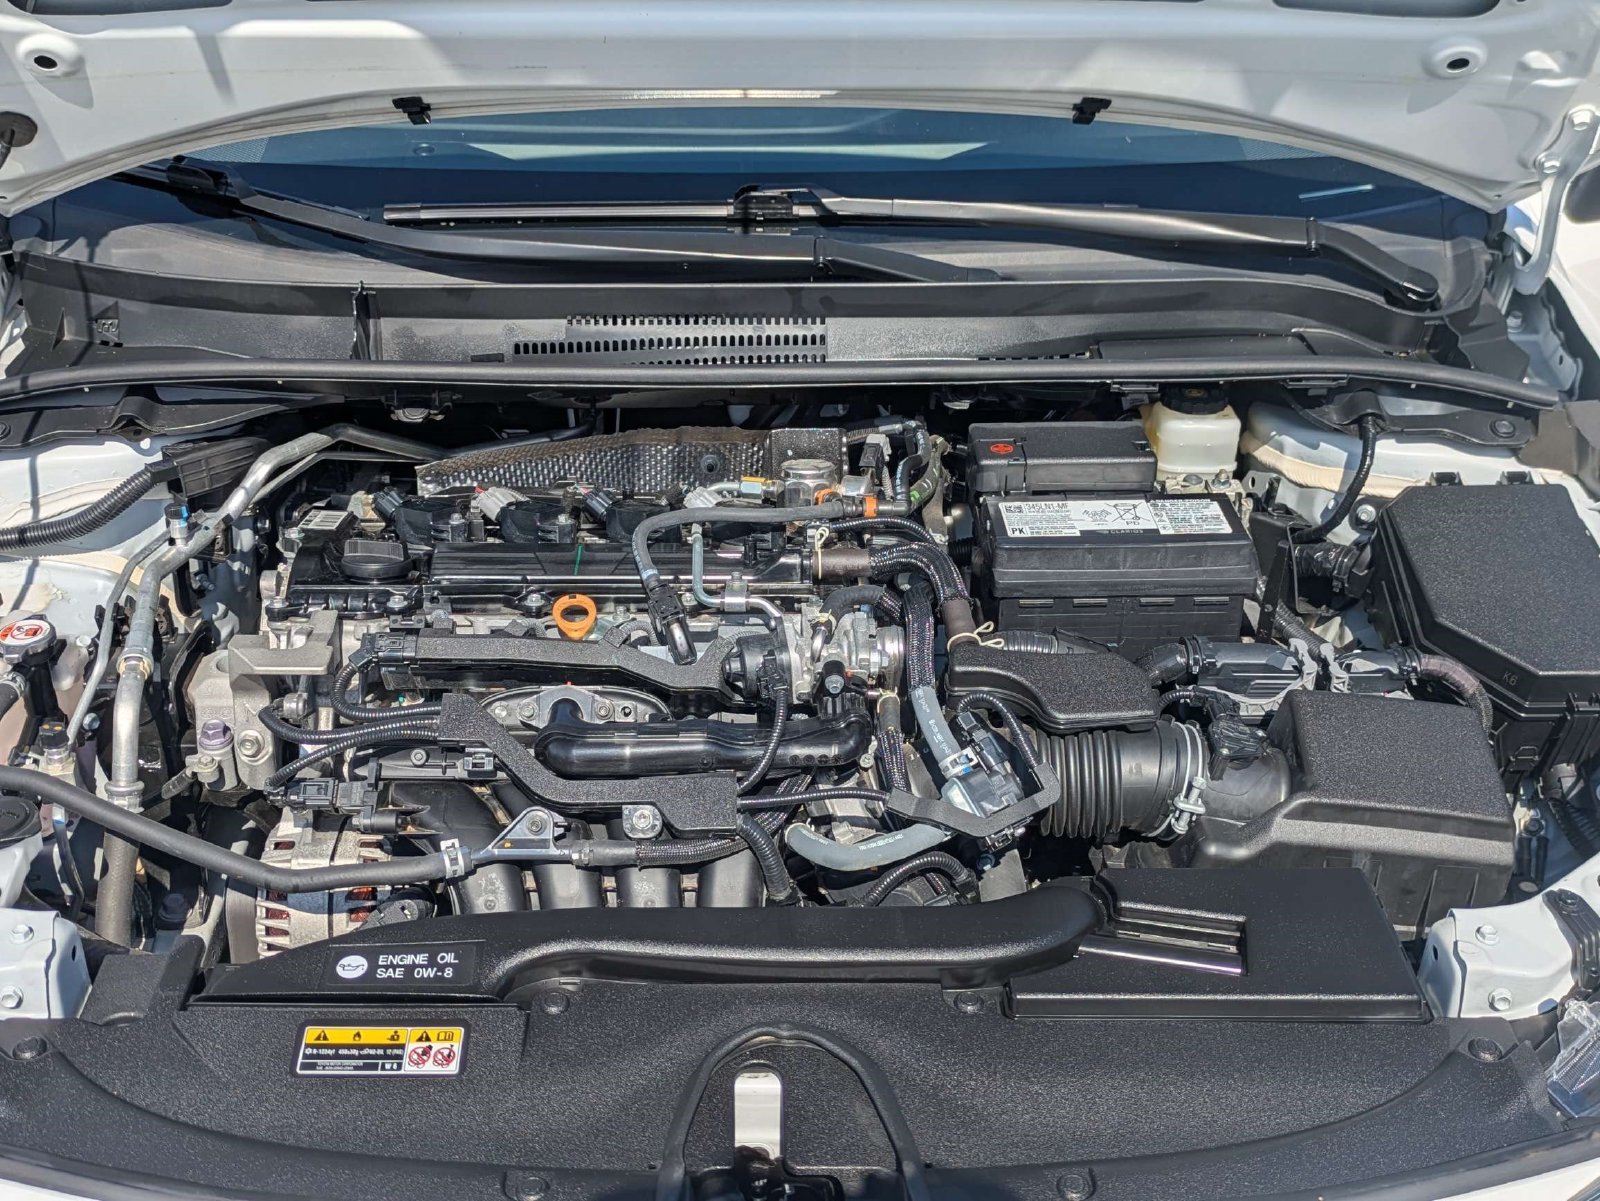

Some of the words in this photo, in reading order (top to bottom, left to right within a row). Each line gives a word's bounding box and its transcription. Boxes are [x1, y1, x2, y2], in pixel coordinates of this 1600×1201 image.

[1012, 527, 1025, 535] PK
[378, 953, 429, 965] ENGINE
[436, 952, 459, 964] OIL
[376, 968, 404, 978] SAE
[414, 967, 453, 978] 0W-8
[385, 1062, 392, 1070] W
